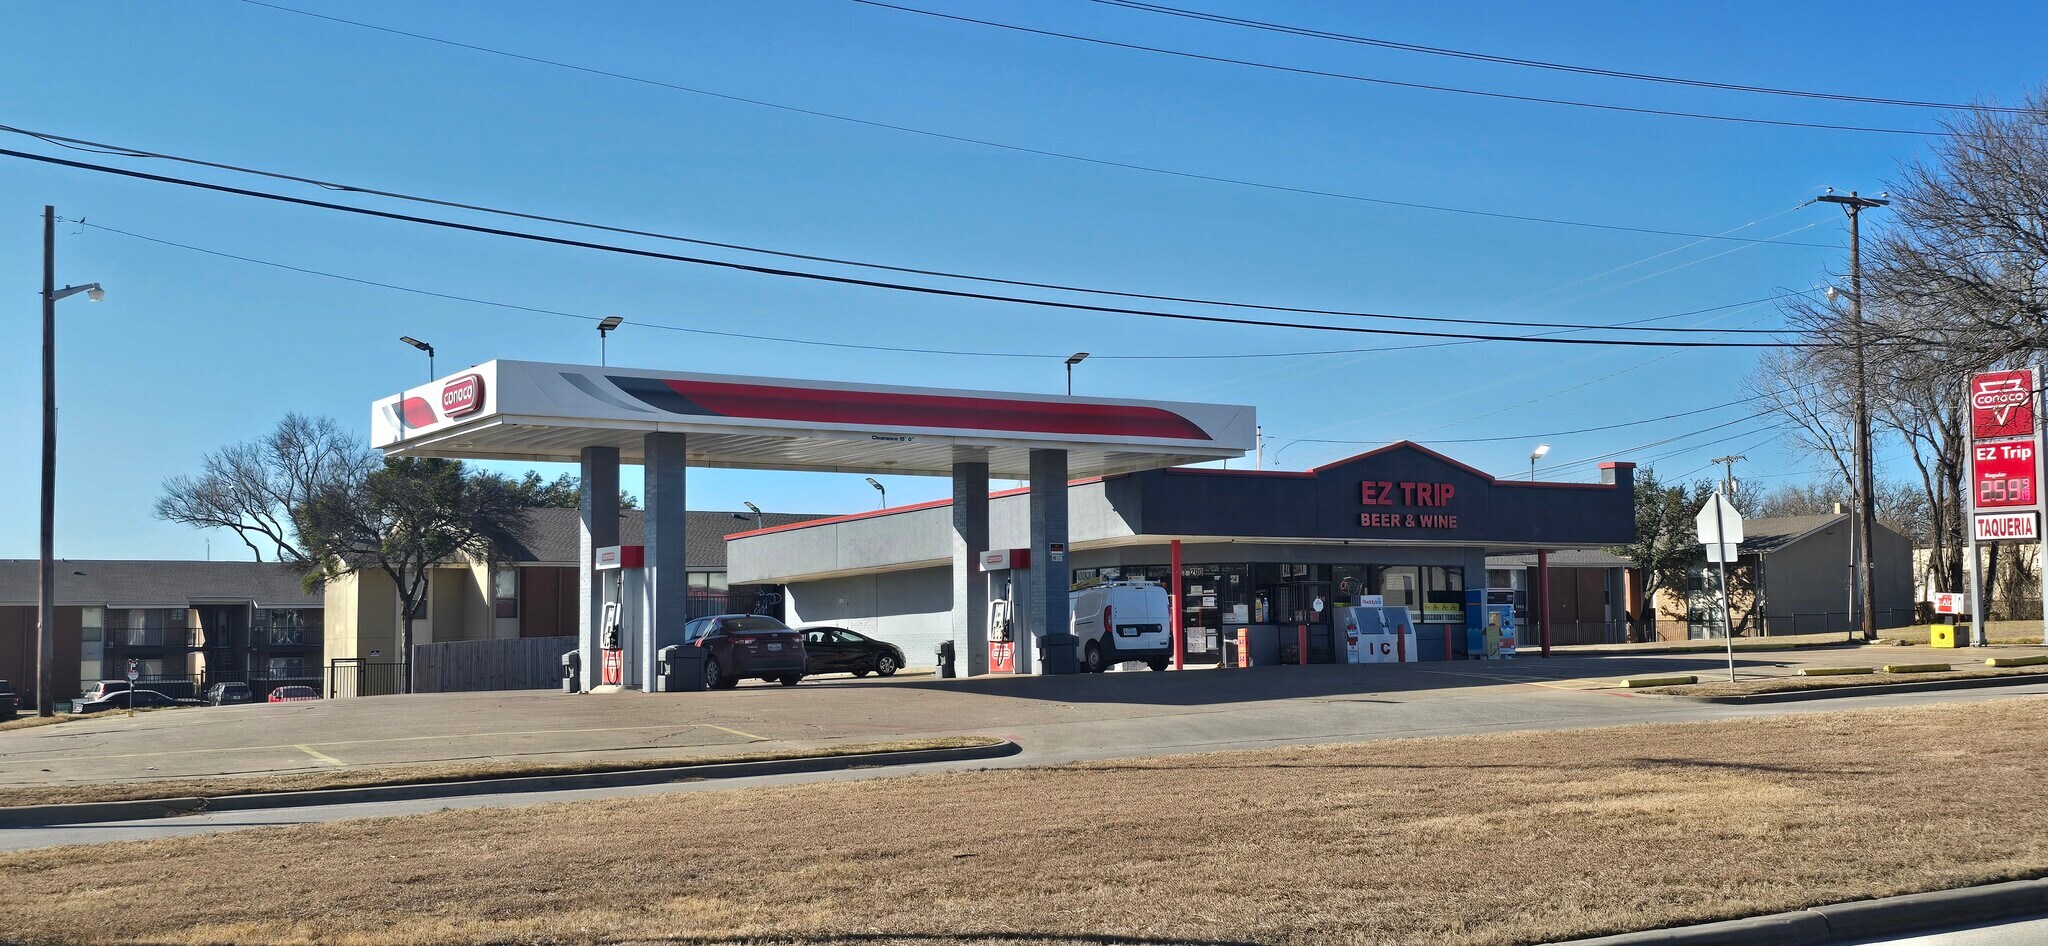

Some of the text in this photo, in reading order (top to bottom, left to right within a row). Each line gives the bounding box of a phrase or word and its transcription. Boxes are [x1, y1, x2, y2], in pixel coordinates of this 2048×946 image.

[444, 385, 473, 405] conoco
[1977, 392, 2024, 404] conoco
[1976, 446, 2032, 460] EZ Trip
[1361, 480, 1455, 506] EZ TRIP
[1360, 513, 1457, 528] BEER & WINE
[1977, 517, 2033, 537] TAQUERIA
